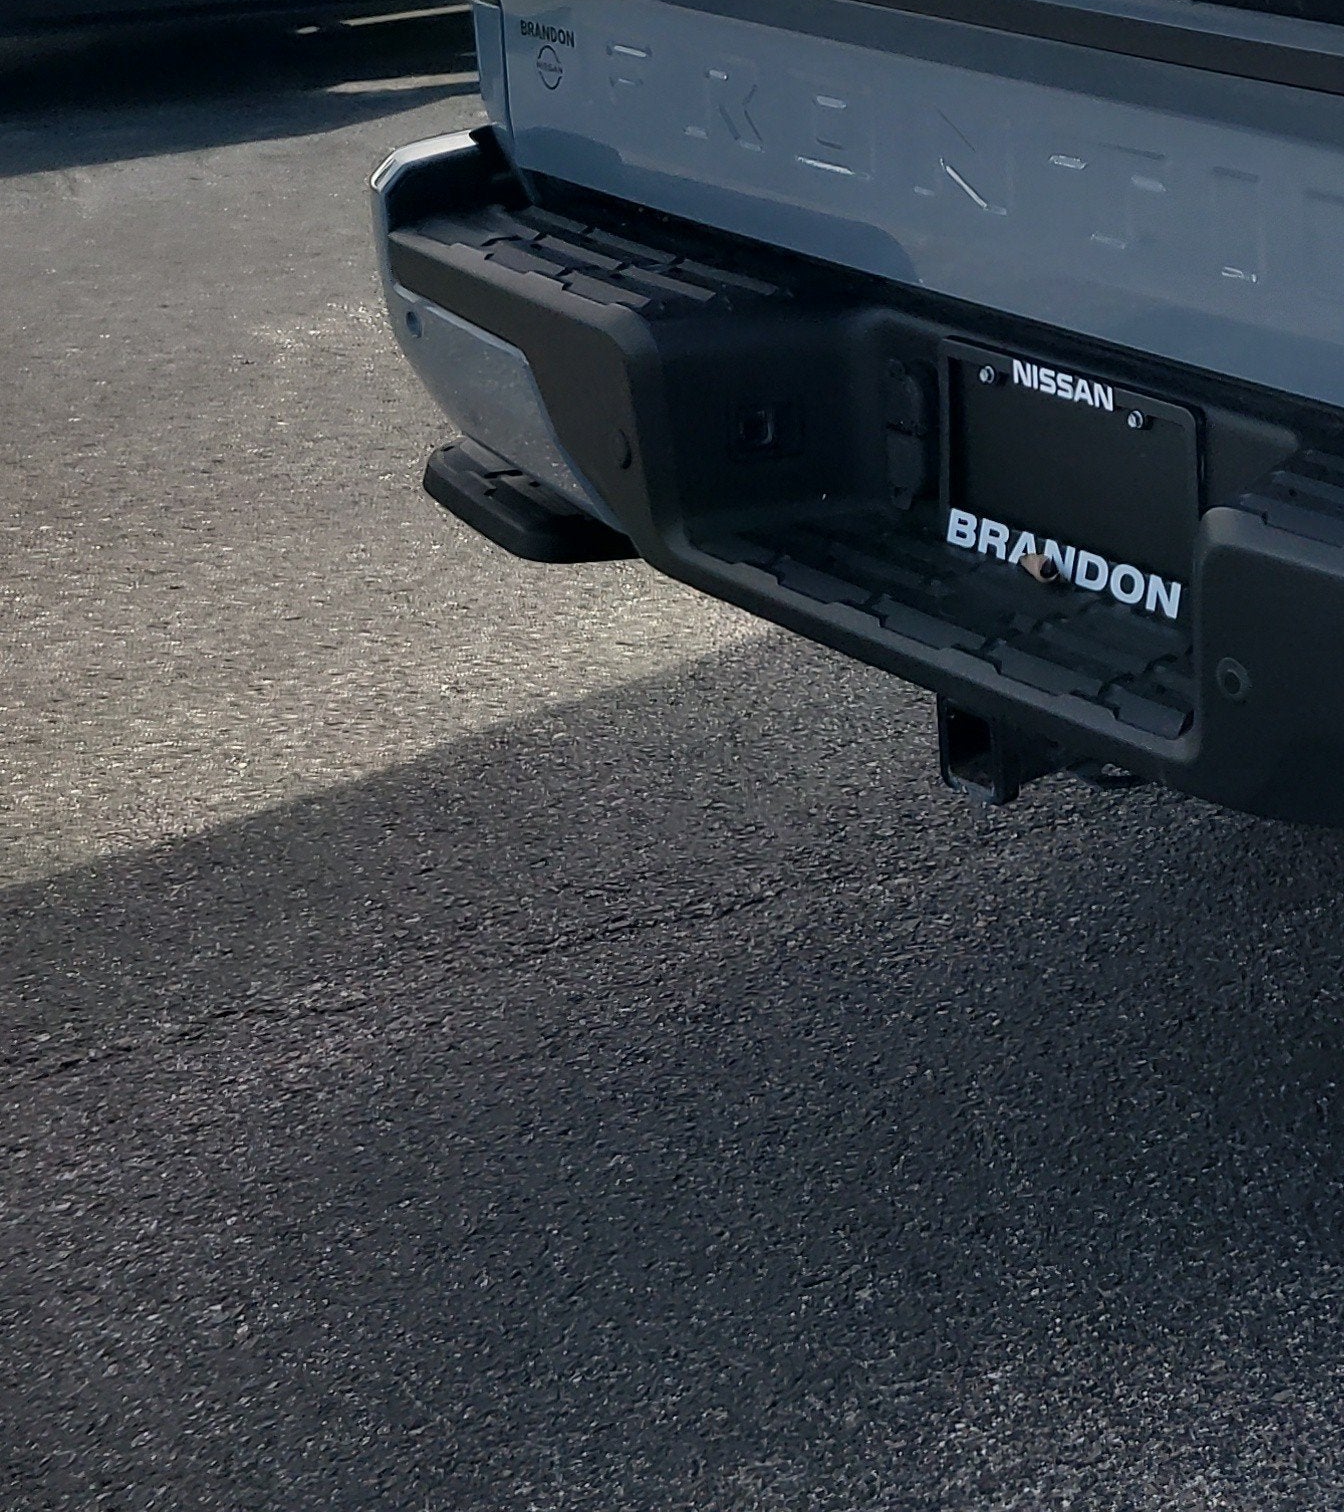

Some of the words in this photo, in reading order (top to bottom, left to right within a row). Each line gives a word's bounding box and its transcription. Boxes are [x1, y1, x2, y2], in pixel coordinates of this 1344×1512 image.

[520, 19, 575, 48] BRANDON
[1012, 358, 1114, 412] NISSAN
[946, 507, 1182, 620] BRANDON
